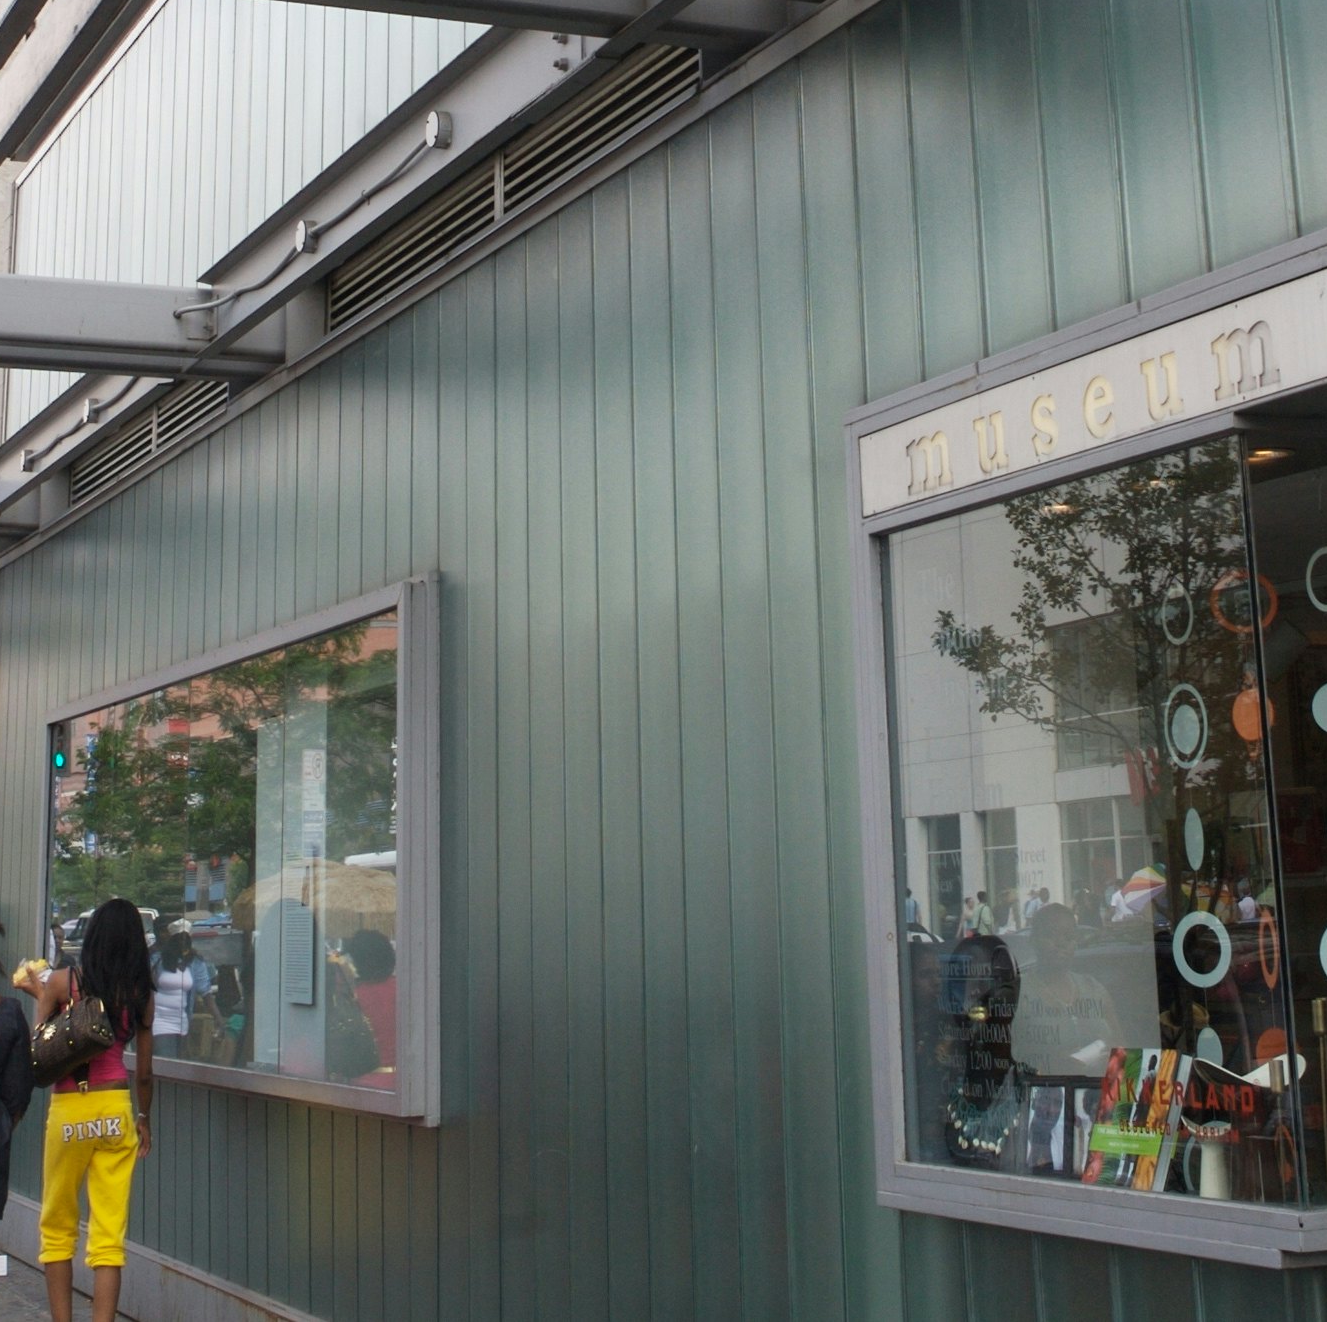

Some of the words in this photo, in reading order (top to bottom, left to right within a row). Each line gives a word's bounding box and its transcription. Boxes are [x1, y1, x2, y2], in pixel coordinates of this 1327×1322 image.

[905, 318, 1280, 497] museum
[962, 958, 993, 977] Hours
[1102, 1076, 1256, 1114] KIKKERLAND
[61, 1116, 123, 1144] PINK
